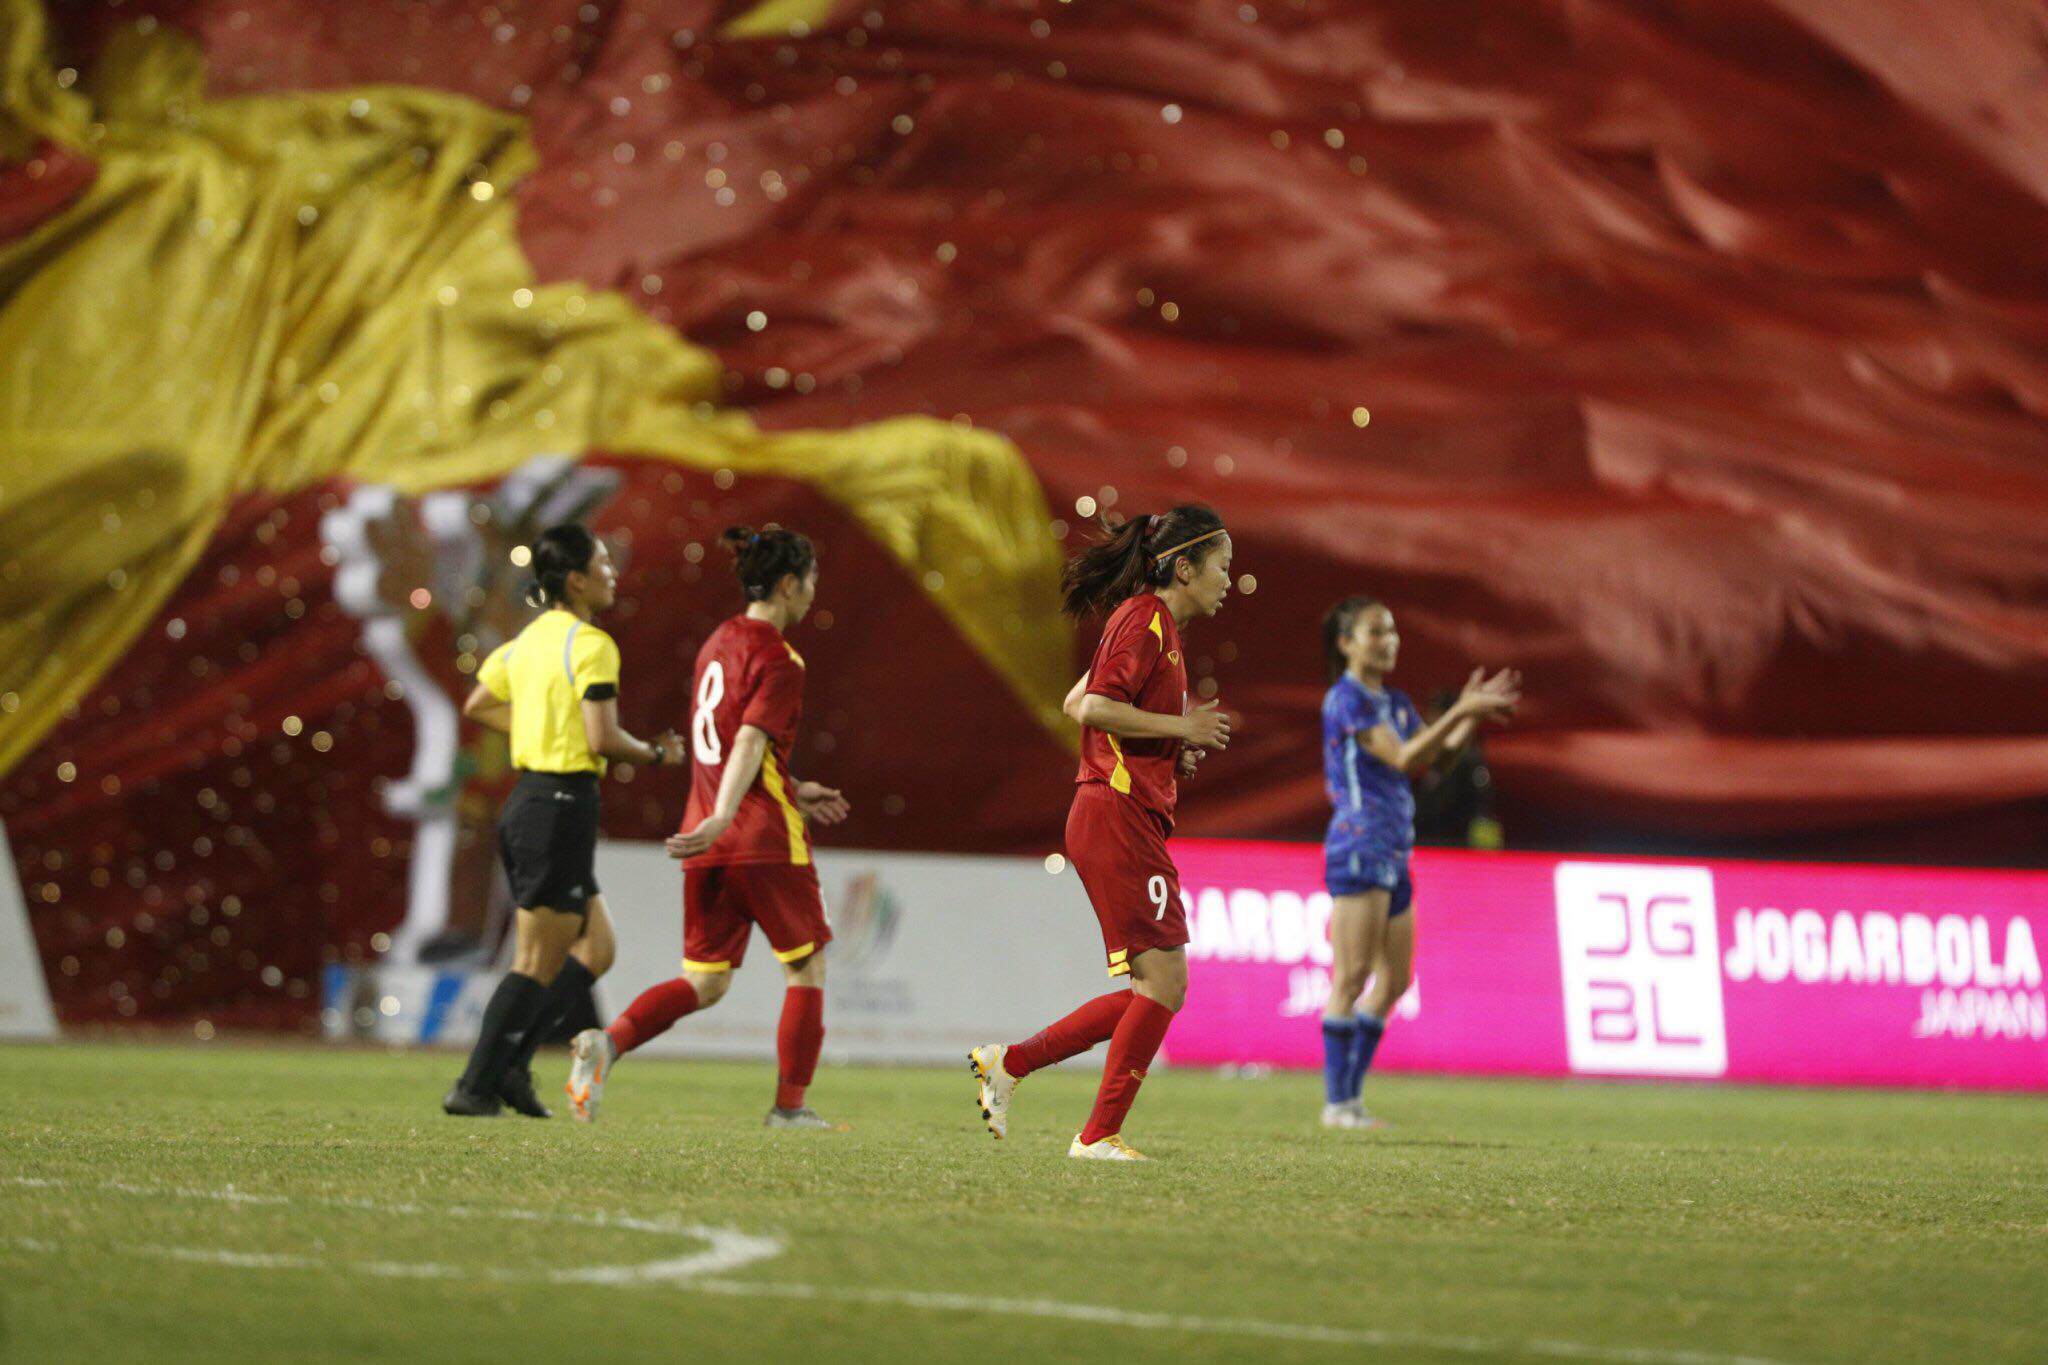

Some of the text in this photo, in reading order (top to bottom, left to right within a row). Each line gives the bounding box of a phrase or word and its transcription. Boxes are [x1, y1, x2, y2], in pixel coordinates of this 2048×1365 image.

[691, 660, 725, 766] 8
[1148, 874, 1169, 921] 9
[1180, 887, 1334, 964] ARBO
[1726, 908, 2041, 987] JOGARBOLA
[1912, 987, 2047, 1040] JAPAN
